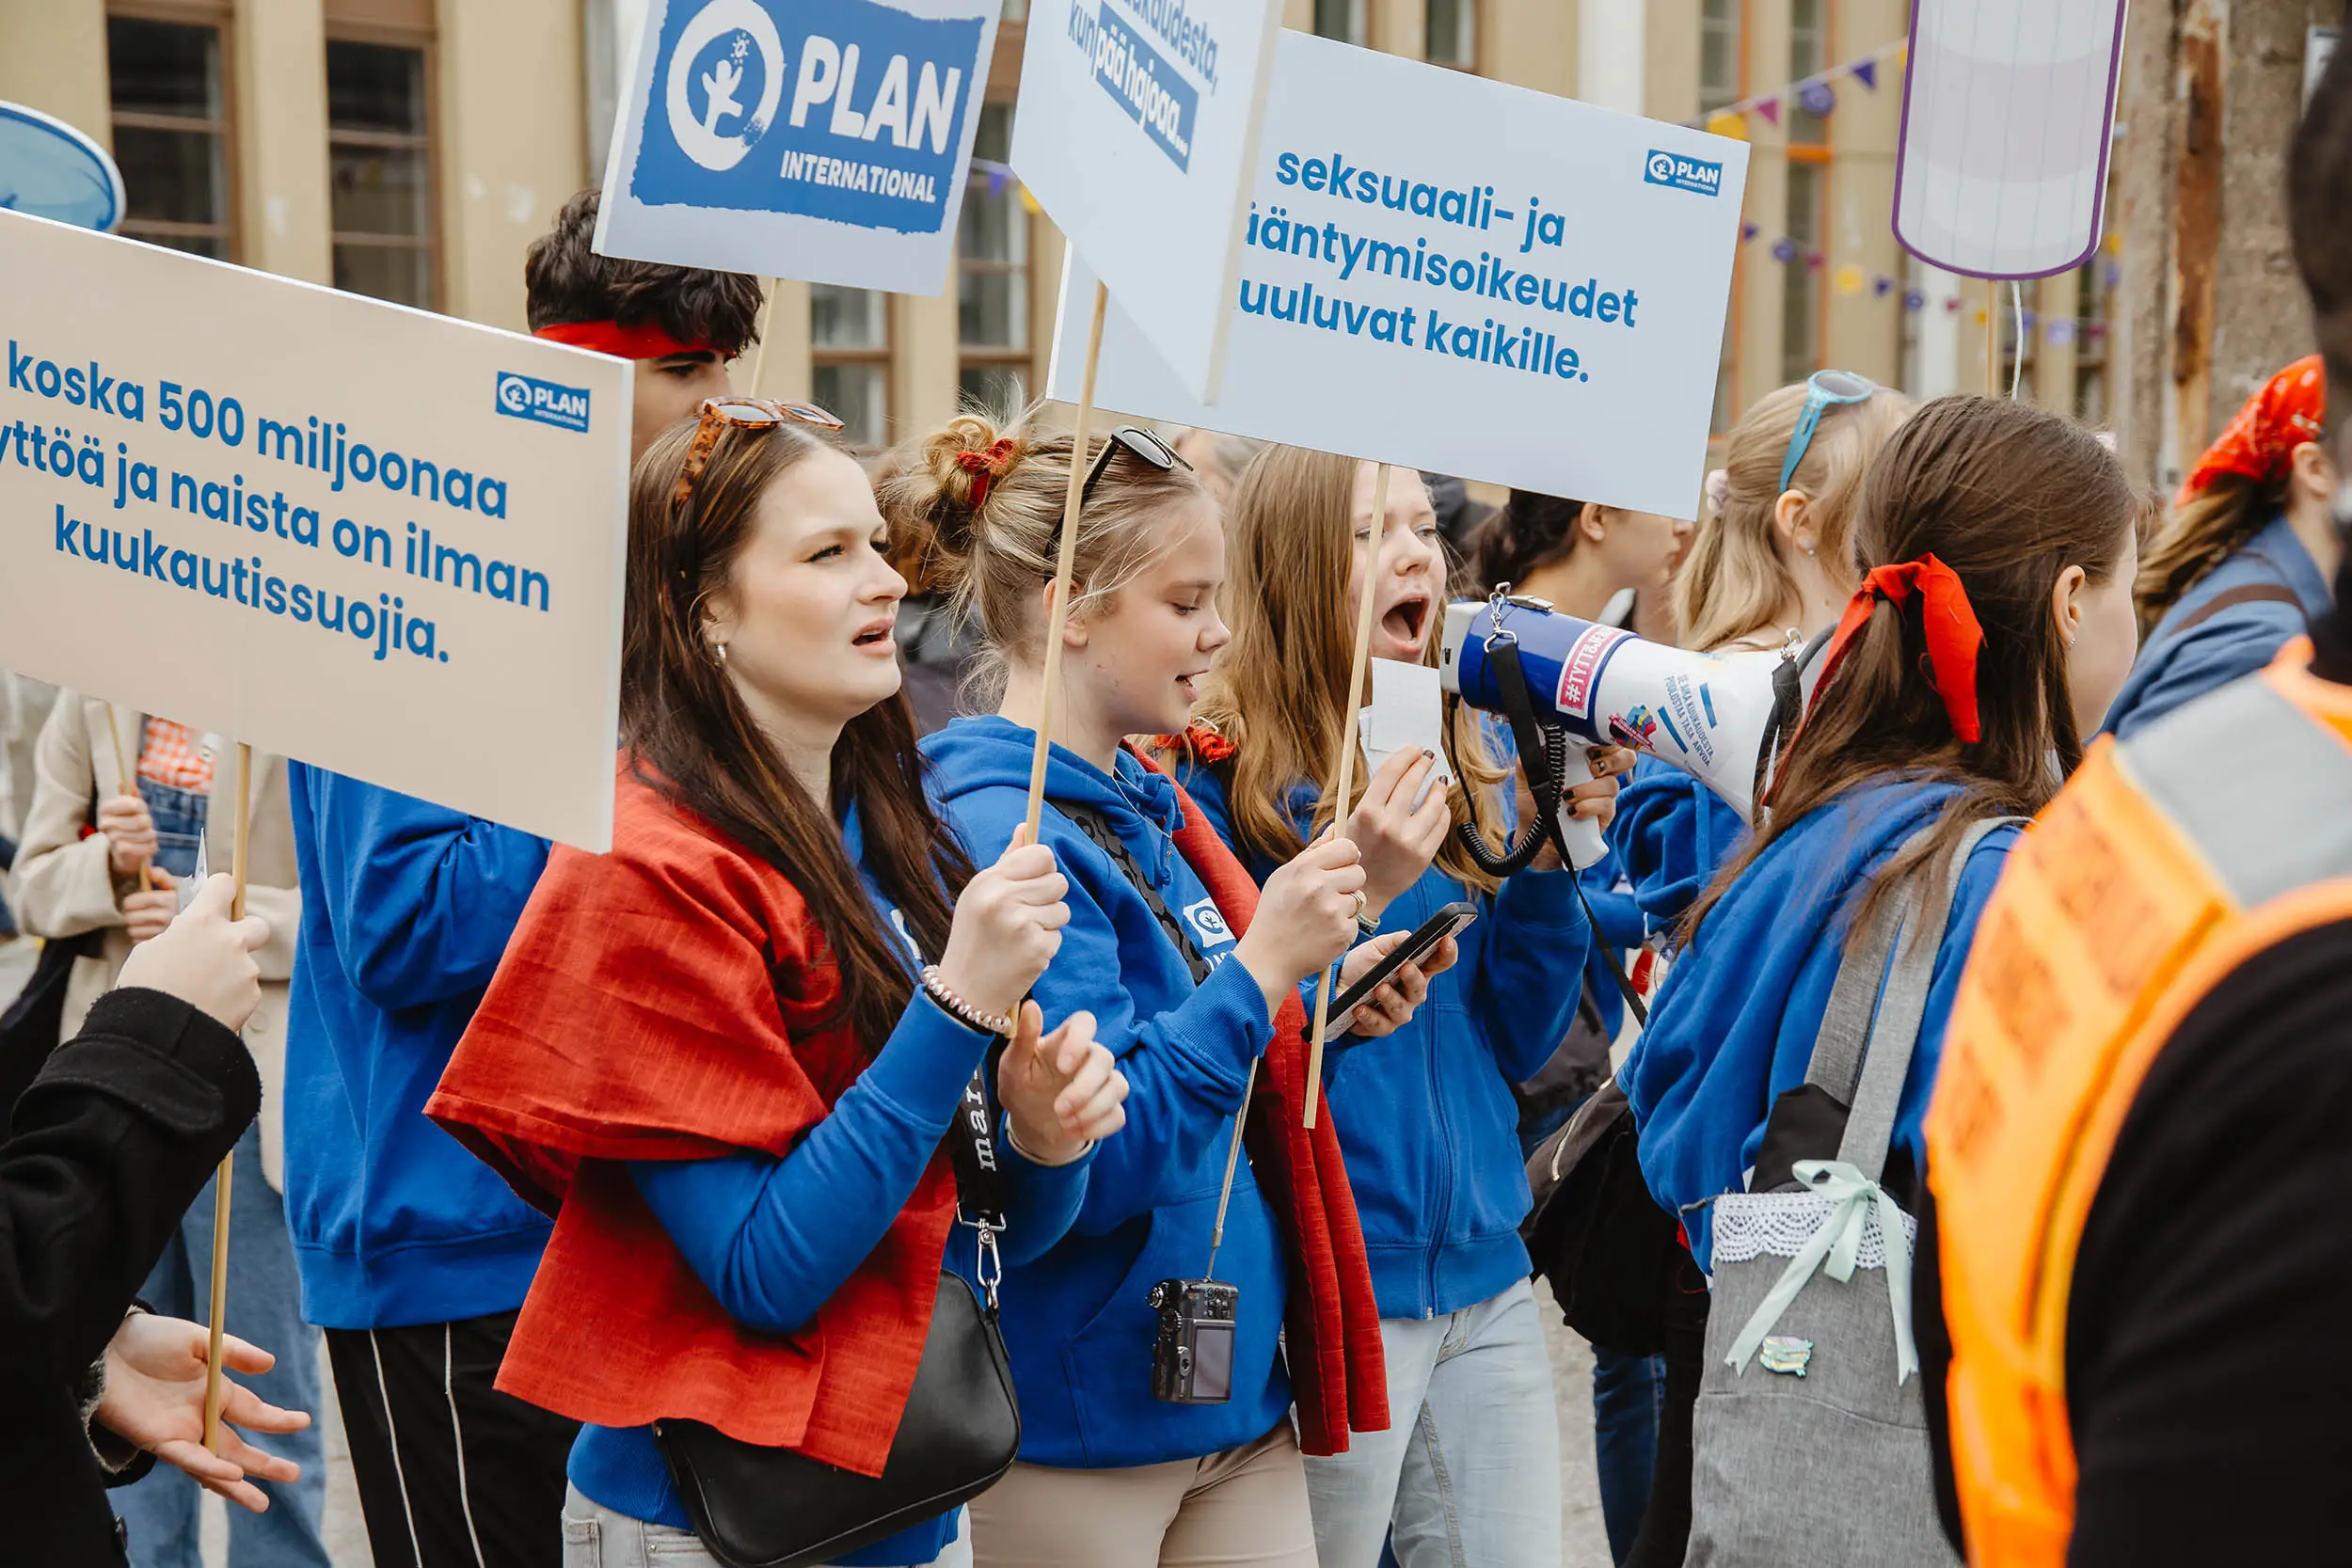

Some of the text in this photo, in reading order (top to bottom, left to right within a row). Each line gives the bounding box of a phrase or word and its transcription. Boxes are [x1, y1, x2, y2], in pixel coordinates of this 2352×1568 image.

[788, 35, 961, 155] PLAN
[1092, 24, 1127, 88] pää
[781, 150, 936, 203] INTERNATIONAL
[1276, 151, 1565, 254] seksuaali- ja
[1677, 161, 1720, 184] PLAN
[1234, 278, 1589, 384] uuluvat kaikille.
[9, 340, 507, 519] koska 500 miljoonaa
[533, 386, 587, 418] PLAN
[114, 442, 158, 509] ja
[172, 472, 319, 547] naista
[333, 518, 391, 568] on
[407, 522, 549, 612] ilman
[56, 504, 449, 663] kuukautissuojia.
[965, 1069, 997, 1172] mar
